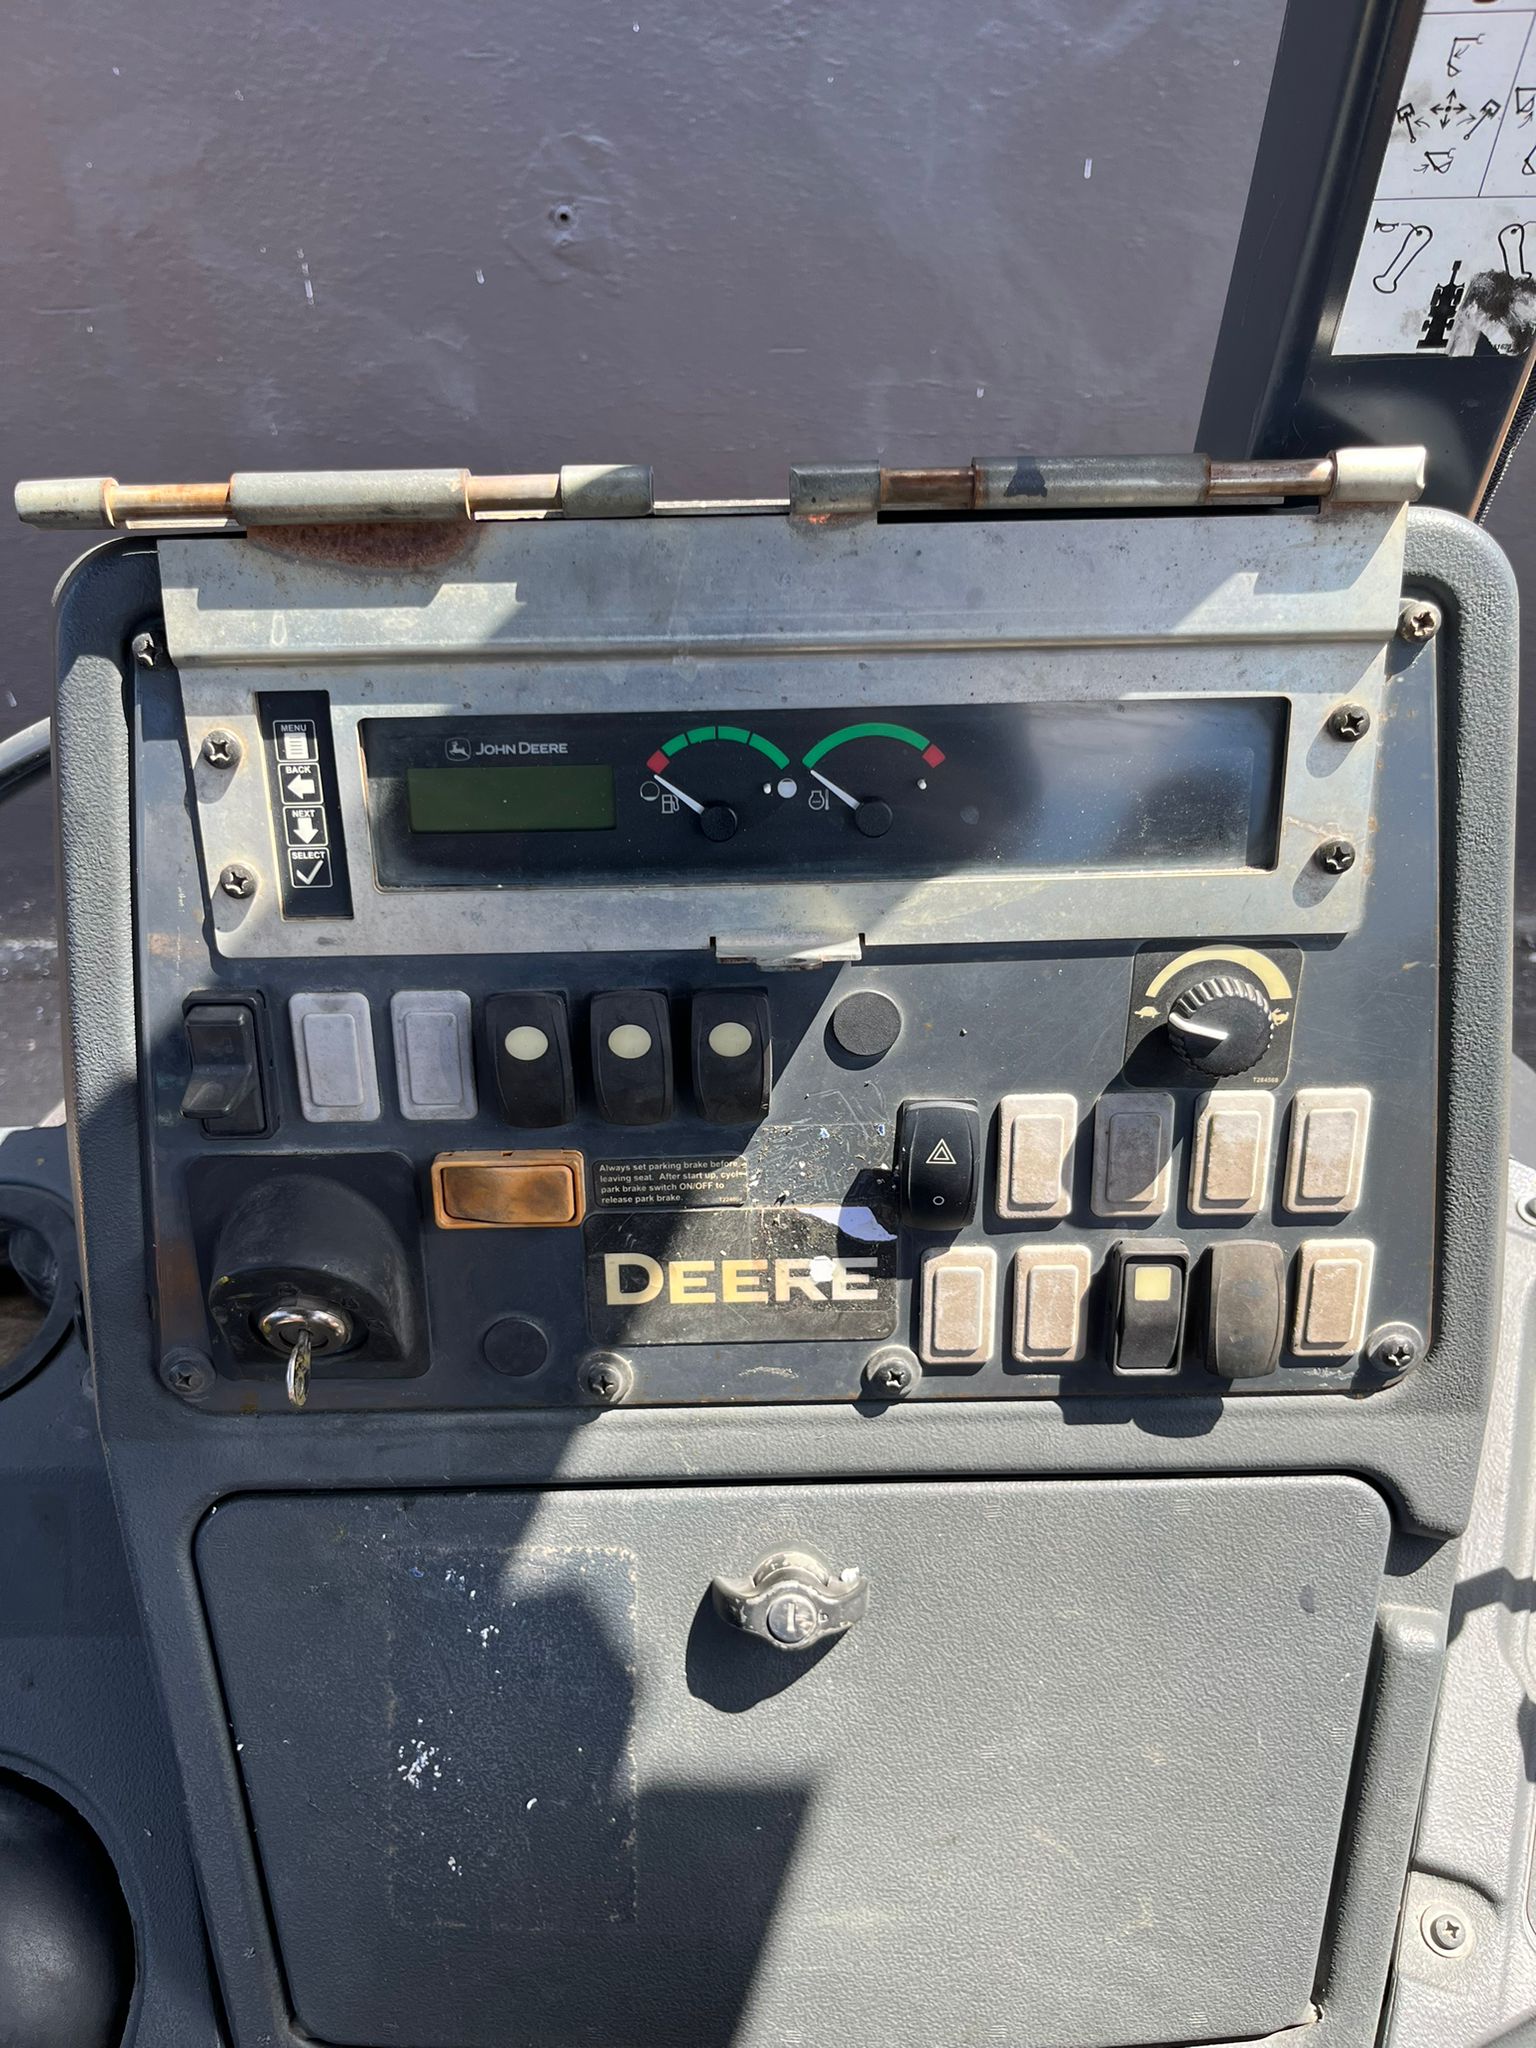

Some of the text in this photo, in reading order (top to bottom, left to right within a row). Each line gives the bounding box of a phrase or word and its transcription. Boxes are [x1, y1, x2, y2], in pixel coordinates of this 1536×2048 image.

[281, 723, 308, 733] MENU
[475, 742, 569, 756] JOHN DEERE
[285, 765, 312, 774] BACK
[291, 809, 316, 818] NEXT
[291, 851, 326, 860] SELECT
[599, 1164, 631, 1172] Always
[648, 1162, 682, 1171] parking
[683, 1161, 708, 1169] brake
[599, 1175, 632, 1183] leaving
[659, 1173, 681, 1181] After
[600, 1186, 621, 1194] park
[622, 1185, 647, 1193] brake
[648, 1183, 677, 1191] switch
[679, 1182, 714, 1190] ON/OFF
[601, 1194, 684, 1204] release park brake.
[603, 1252, 879, 1306] DEERE
